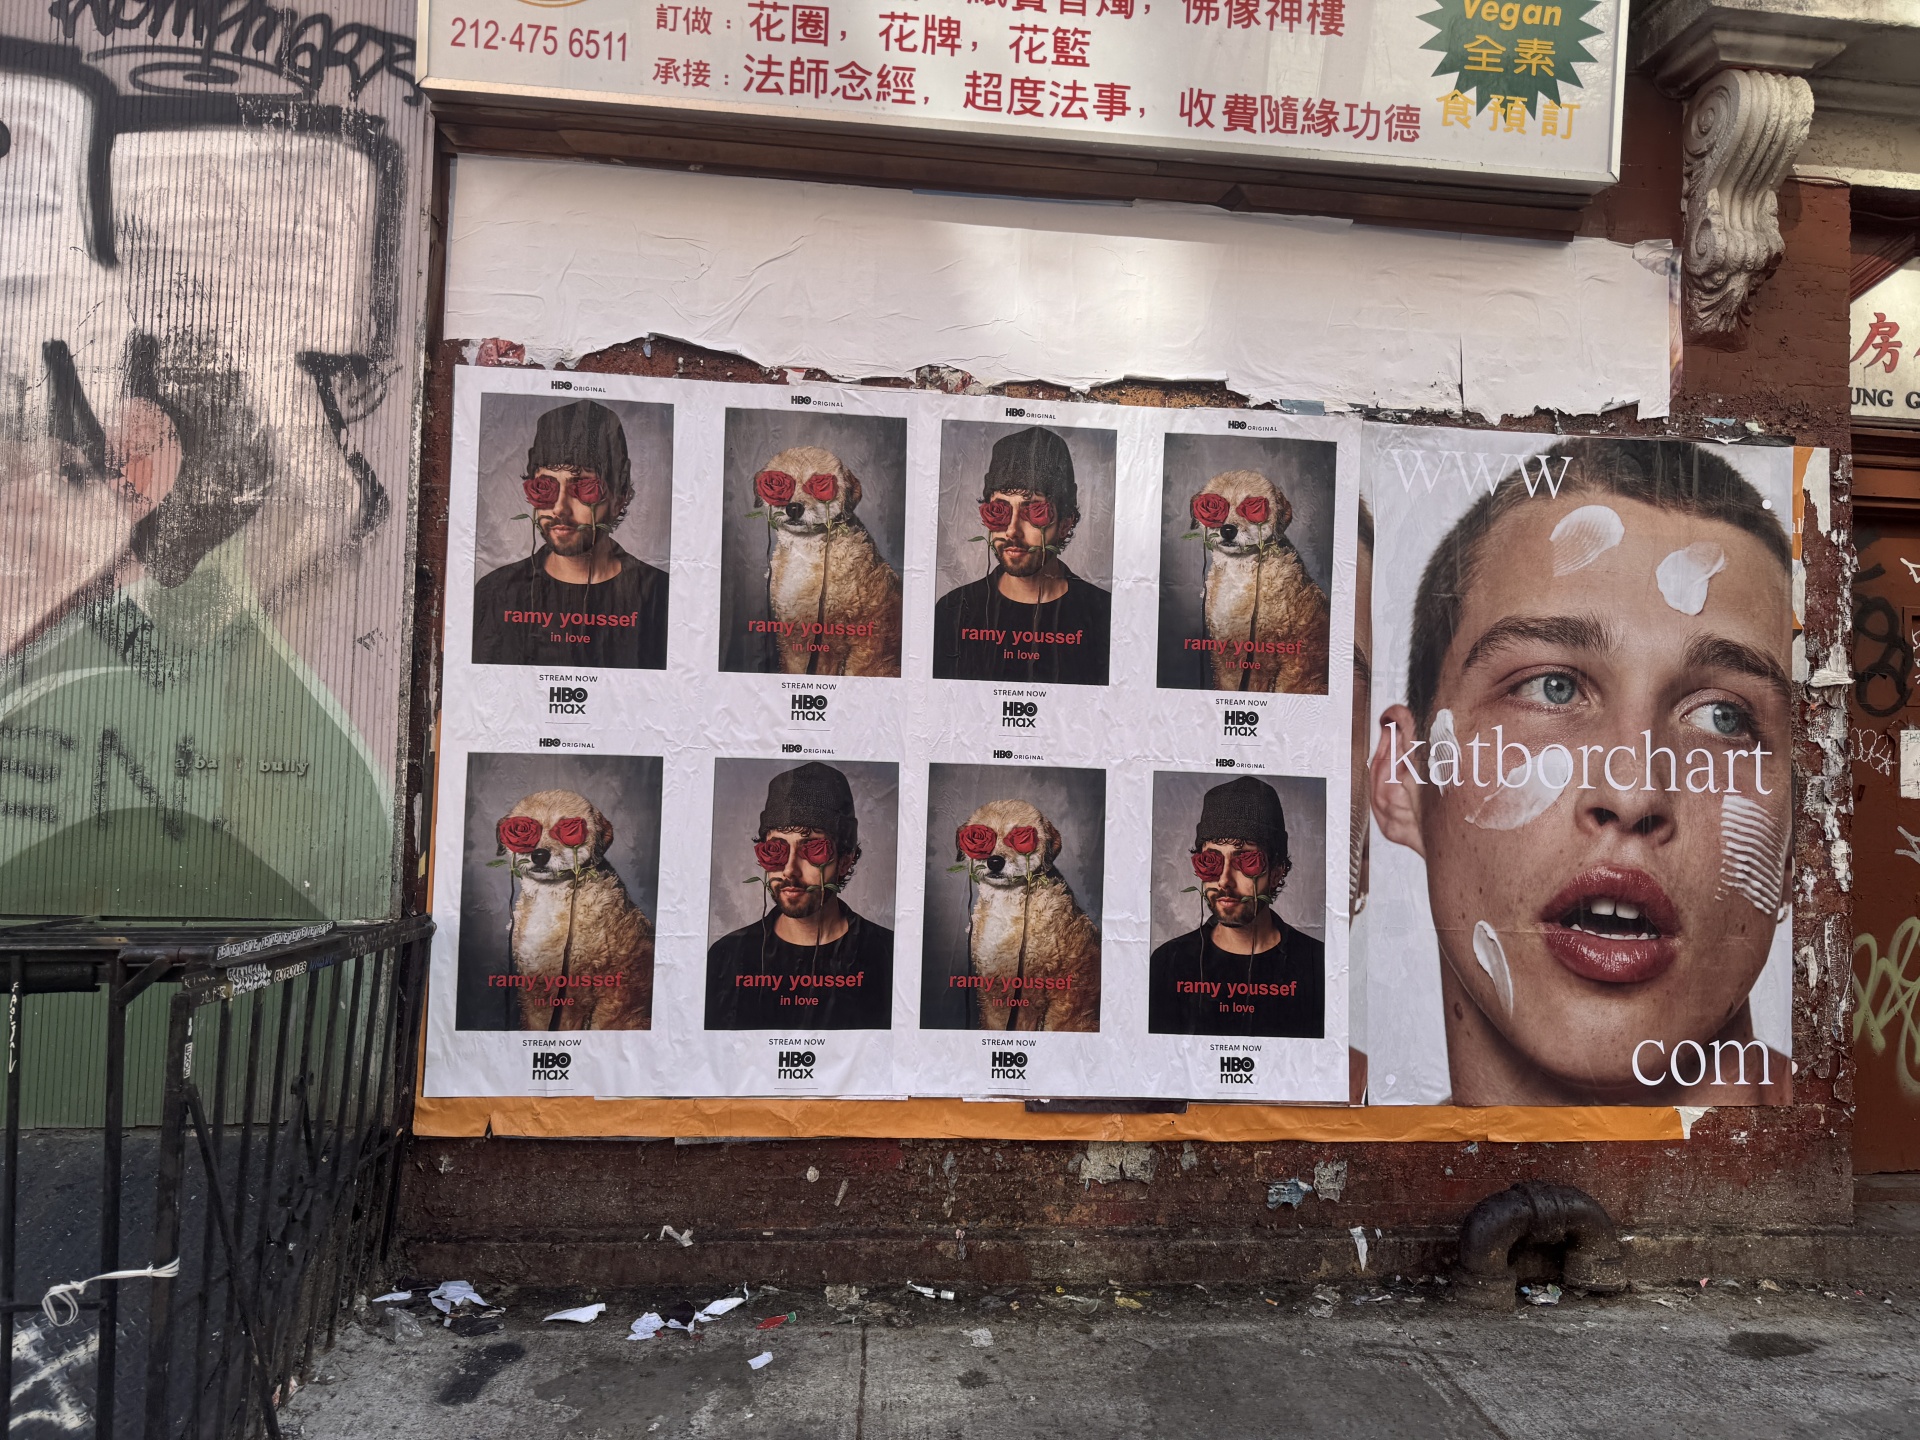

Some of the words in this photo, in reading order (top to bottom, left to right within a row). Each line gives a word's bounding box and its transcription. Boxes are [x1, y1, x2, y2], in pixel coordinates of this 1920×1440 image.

[1464, 0, 1562, 31] Vegan
[568, 27, 627, 62] 6511
[1463, 34, 1556, 76] 全素
[1436, 89, 1581, 139] 食預訂
[551, 381, 572, 390] HBO
[574, 385, 606, 393] ORIGINAL
[791, 396, 811, 405] HBO
[1006, 408, 1025, 417] HBO
[1228, 421, 1246, 430] HBO
[504, 608, 553, 627] ramy
[560, 611, 638, 628] youssef
[748, 618, 794, 636] ramy
[801, 621, 874, 638] youssef
[551, 632, 562, 643] in
[565, 632, 590, 644] love
[961, 627, 1006, 644] ramy
[1012, 629, 1083, 646] youssef
[792, 642, 803, 651] in
[806, 642, 829, 652] love
[1184, 637, 1228, 655] ramy
[1233, 640, 1301, 656] youssef
[1004, 650, 1014, 659] in
[1017, 650, 1040, 661] love
[1225, 659, 1235, 668] in
[1238, 660, 1261, 670] love
[539, 674, 572, 682] STREAM
[575, 675, 598, 683] NOW
[781, 682, 812, 690] STREAM
[549, 687, 587, 703] HBO
[993, 689, 1023, 697] STREAM
[1026, 690, 1047, 698] NOW
[792, 695, 827, 710] HBO
[1215, 699, 1245, 707] STREAM
[549, 703, 585, 715] max
[1003, 702, 1037, 717] HBO
[792, 710, 825, 721] max
[1225, 711, 1259, 726] HBO
[1003, 717, 1036, 728] max
[1224, 726, 1257, 737] max
[539, 738, 560, 748] HBO
[782, 744, 802, 753] HBO
[993, 750, 1013, 759] HBO
[1384, 722, 1773, 795] katborchart
[1216, 759, 1235, 768] HBO
[488, 972, 536, 991] ramy
[544, 972, 623, 991] youssef
[735, 972, 783, 990] ramy
[789, 972, 863, 990] youssef
[949, 973, 994, 992] ramy
[1001, 975, 1072, 992] youssef
[1176, 980, 1221, 997] ramy
[1227, 981, 1297, 997] youssef
[534, 996, 546, 1006] in
[549, 996, 574, 1006] love
[780, 996, 791, 1006] in
[794, 996, 819, 1006] love
[993, 997, 1003, 1006] in
[1006, 997, 1029, 1007] love
[1220, 1003, 1230, 1012] in
[1233, 1003, 1255, 1013] love
[523, 1039, 555, 1047] STREAM
[559, 1039, 582, 1047] NOW
[769, 1039, 800, 1047] STREAM
[982, 1039, 1013, 1047] STREAM
[1016, 1039, 1036, 1047] NOW
[1210, 1044, 1240, 1052] STREAM
[1243, 1044, 1262, 1052] NOW
[533, 1053, 571, 1068] HBO
[779, 1052, 816, 1067] HBO
[992, 1052, 1027, 1068] HBO
[1220, 1057, 1255, 1072] HBO
[1631, 1037, 1774, 1087] com
[532, 1068, 569, 1080] max
[778, 1067, 813, 1079] max
[991, 1068, 1026, 1080] max
[1220, 1072, 1253, 1084] max
